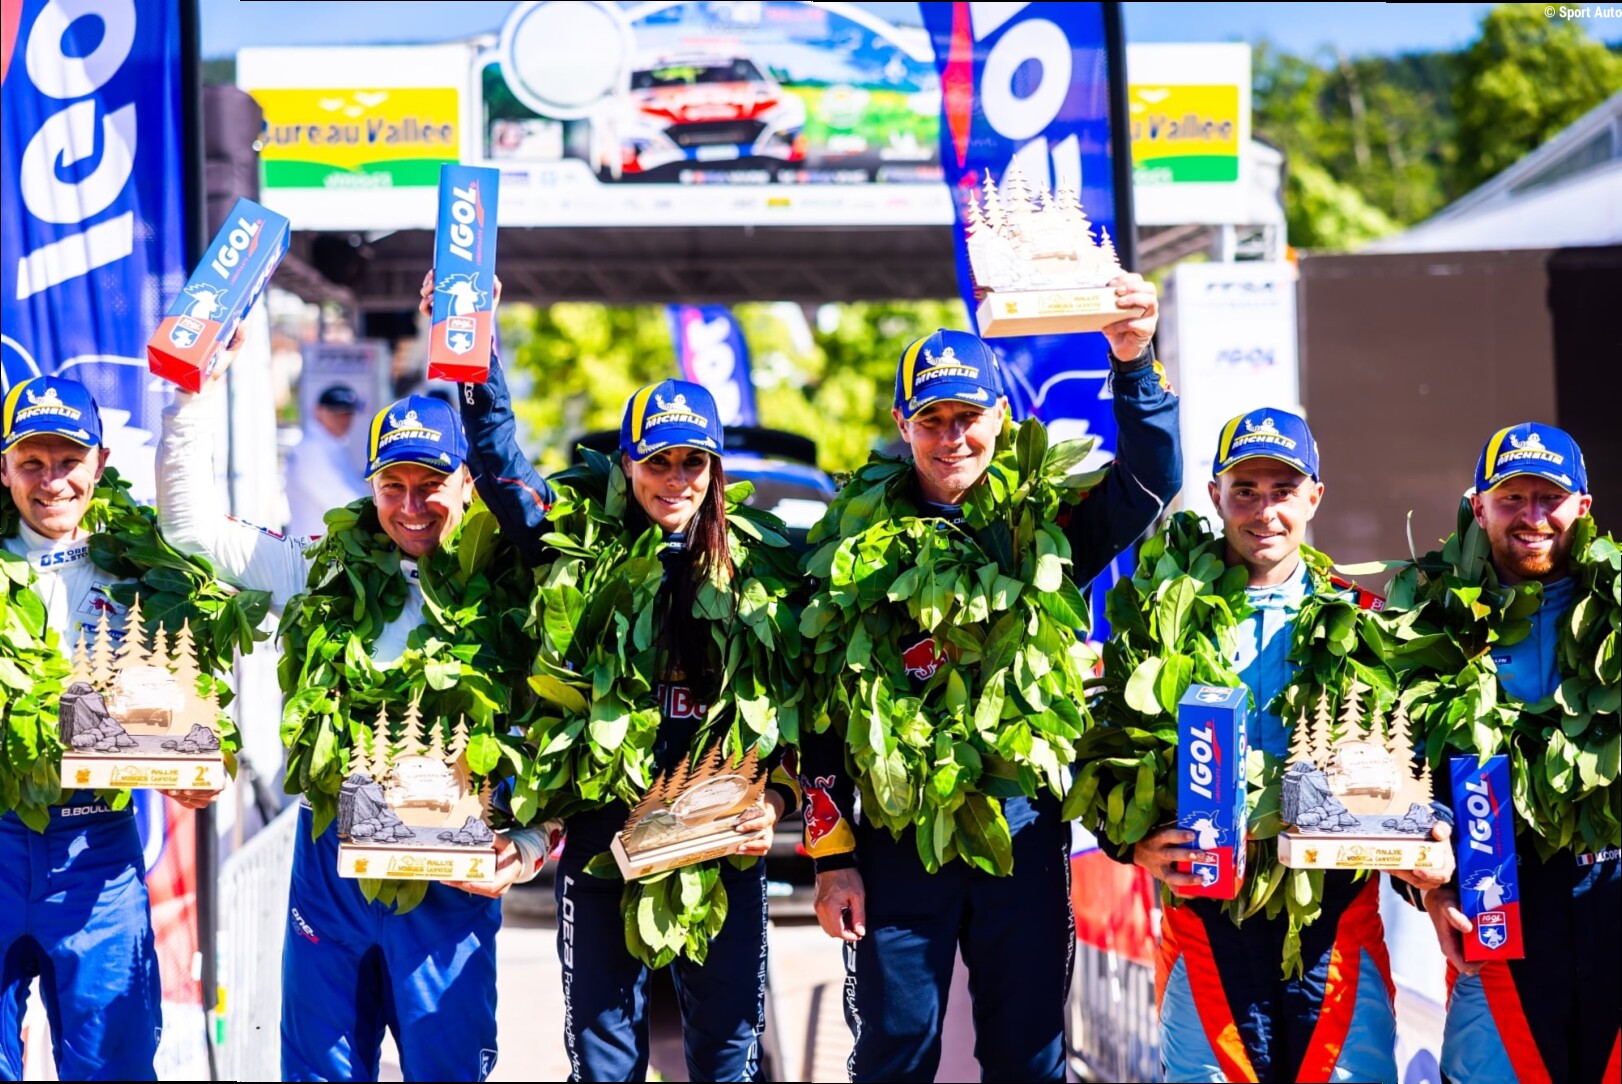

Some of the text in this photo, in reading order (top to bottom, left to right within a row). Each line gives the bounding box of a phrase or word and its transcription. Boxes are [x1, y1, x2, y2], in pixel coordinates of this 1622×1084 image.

[450, 186, 477, 262] IGOL
[211, 217, 259, 280] IGOL
[915, 368, 978, 386] MICHELIN
[15, 406, 80, 423] MICHELIN
[645, 414, 708, 430] MICHELIN
[379, 431, 441, 449] MICHELIN
[1232, 436, 1296, 450] MICHELIN
[1497, 451, 1563, 466] MICHELIN
[1190, 726, 1213, 800] IGOL
[1465, 780, 1493, 855] IGOL
